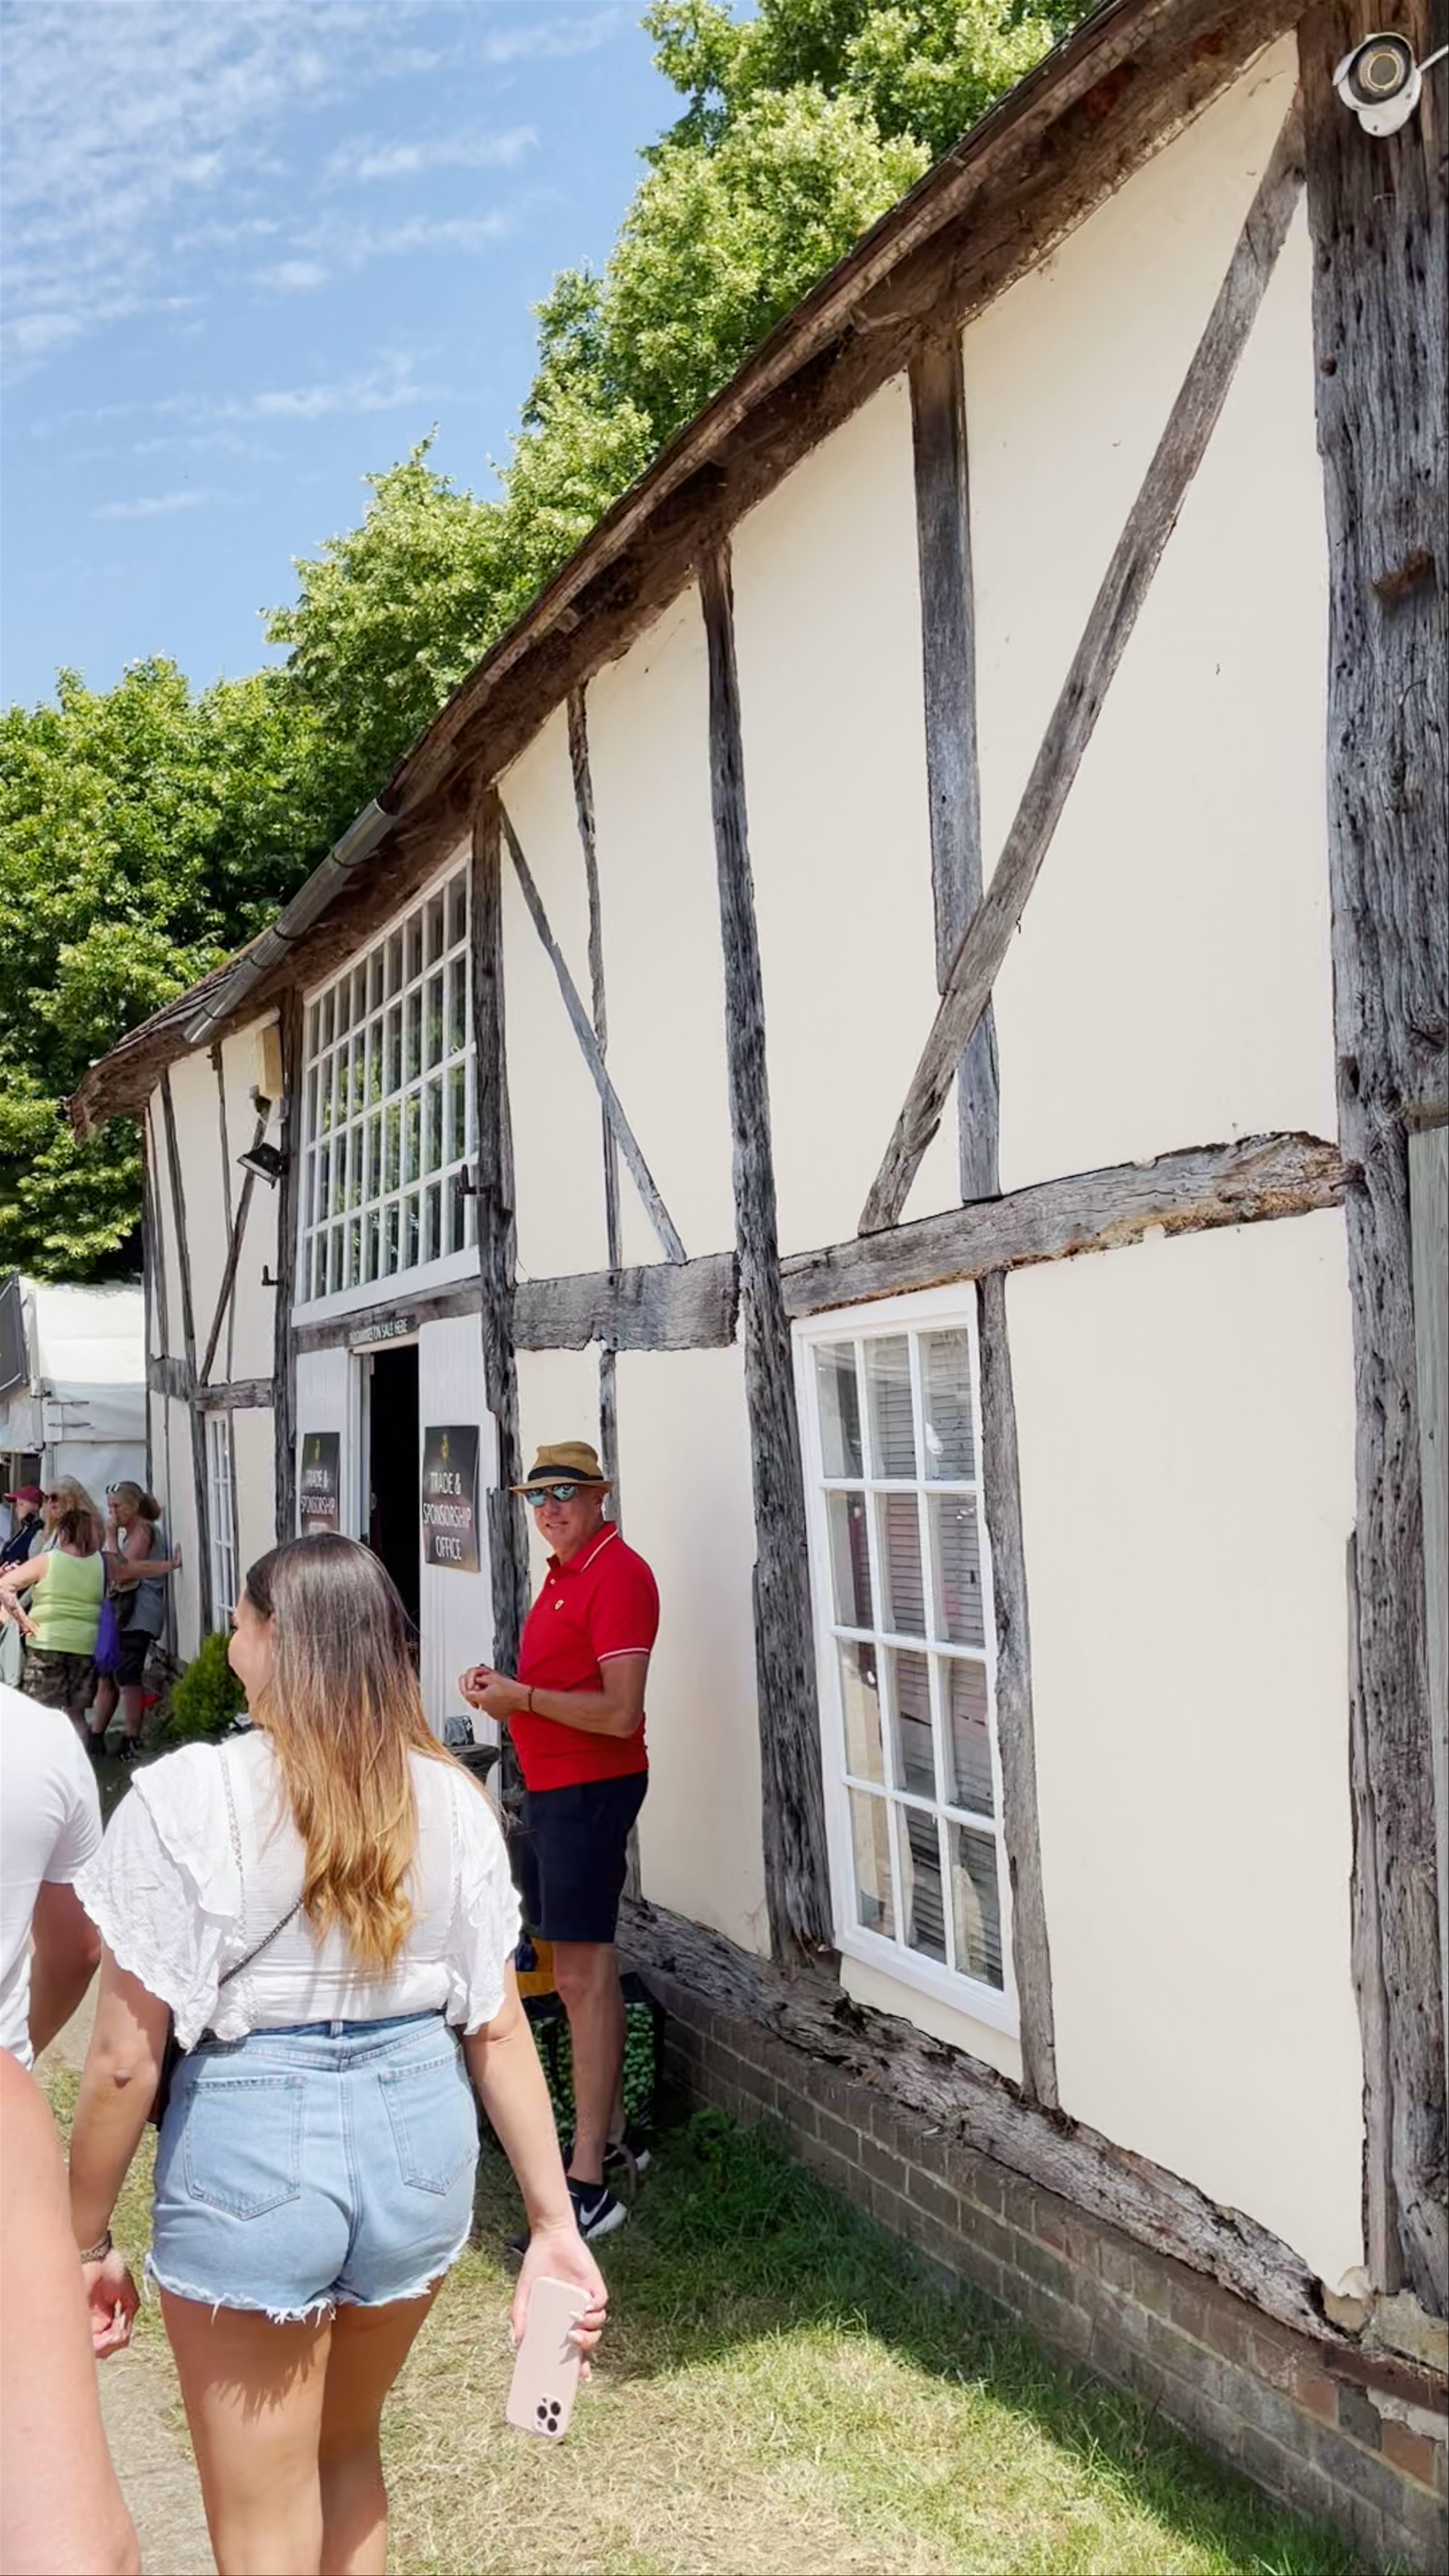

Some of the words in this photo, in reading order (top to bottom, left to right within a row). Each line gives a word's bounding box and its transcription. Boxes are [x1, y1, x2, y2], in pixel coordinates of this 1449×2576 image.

[430, 1472, 453, 1495] TRADE
[454, 1472, 461, 1495] &
[423, 1503, 471, 1528] SPONSORSHIP
[435, 1535, 461, 1560] OFFICE
